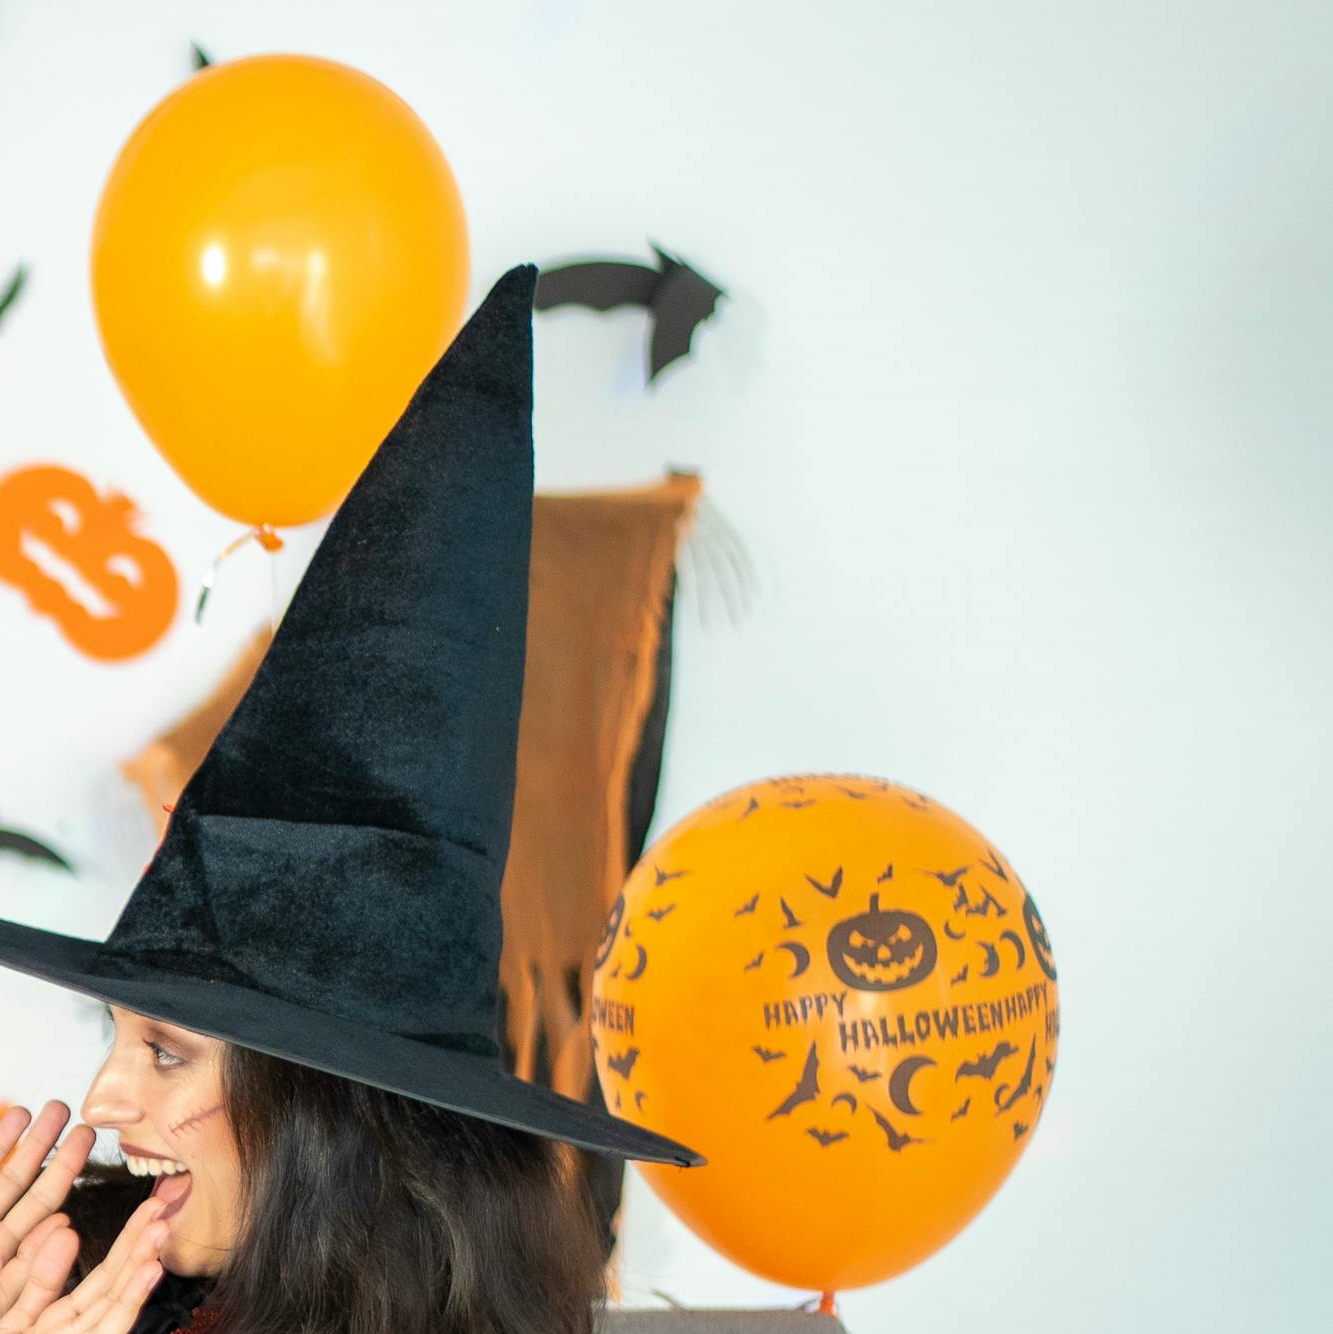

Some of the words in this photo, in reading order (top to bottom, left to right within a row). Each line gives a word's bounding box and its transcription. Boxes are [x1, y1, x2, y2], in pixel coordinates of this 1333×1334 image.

[763, 991, 848, 1030] HAPPY
[838, 1002, 1004, 1053] HALLOWEEN
[1004, 981, 1047, 1024] HAPPY
